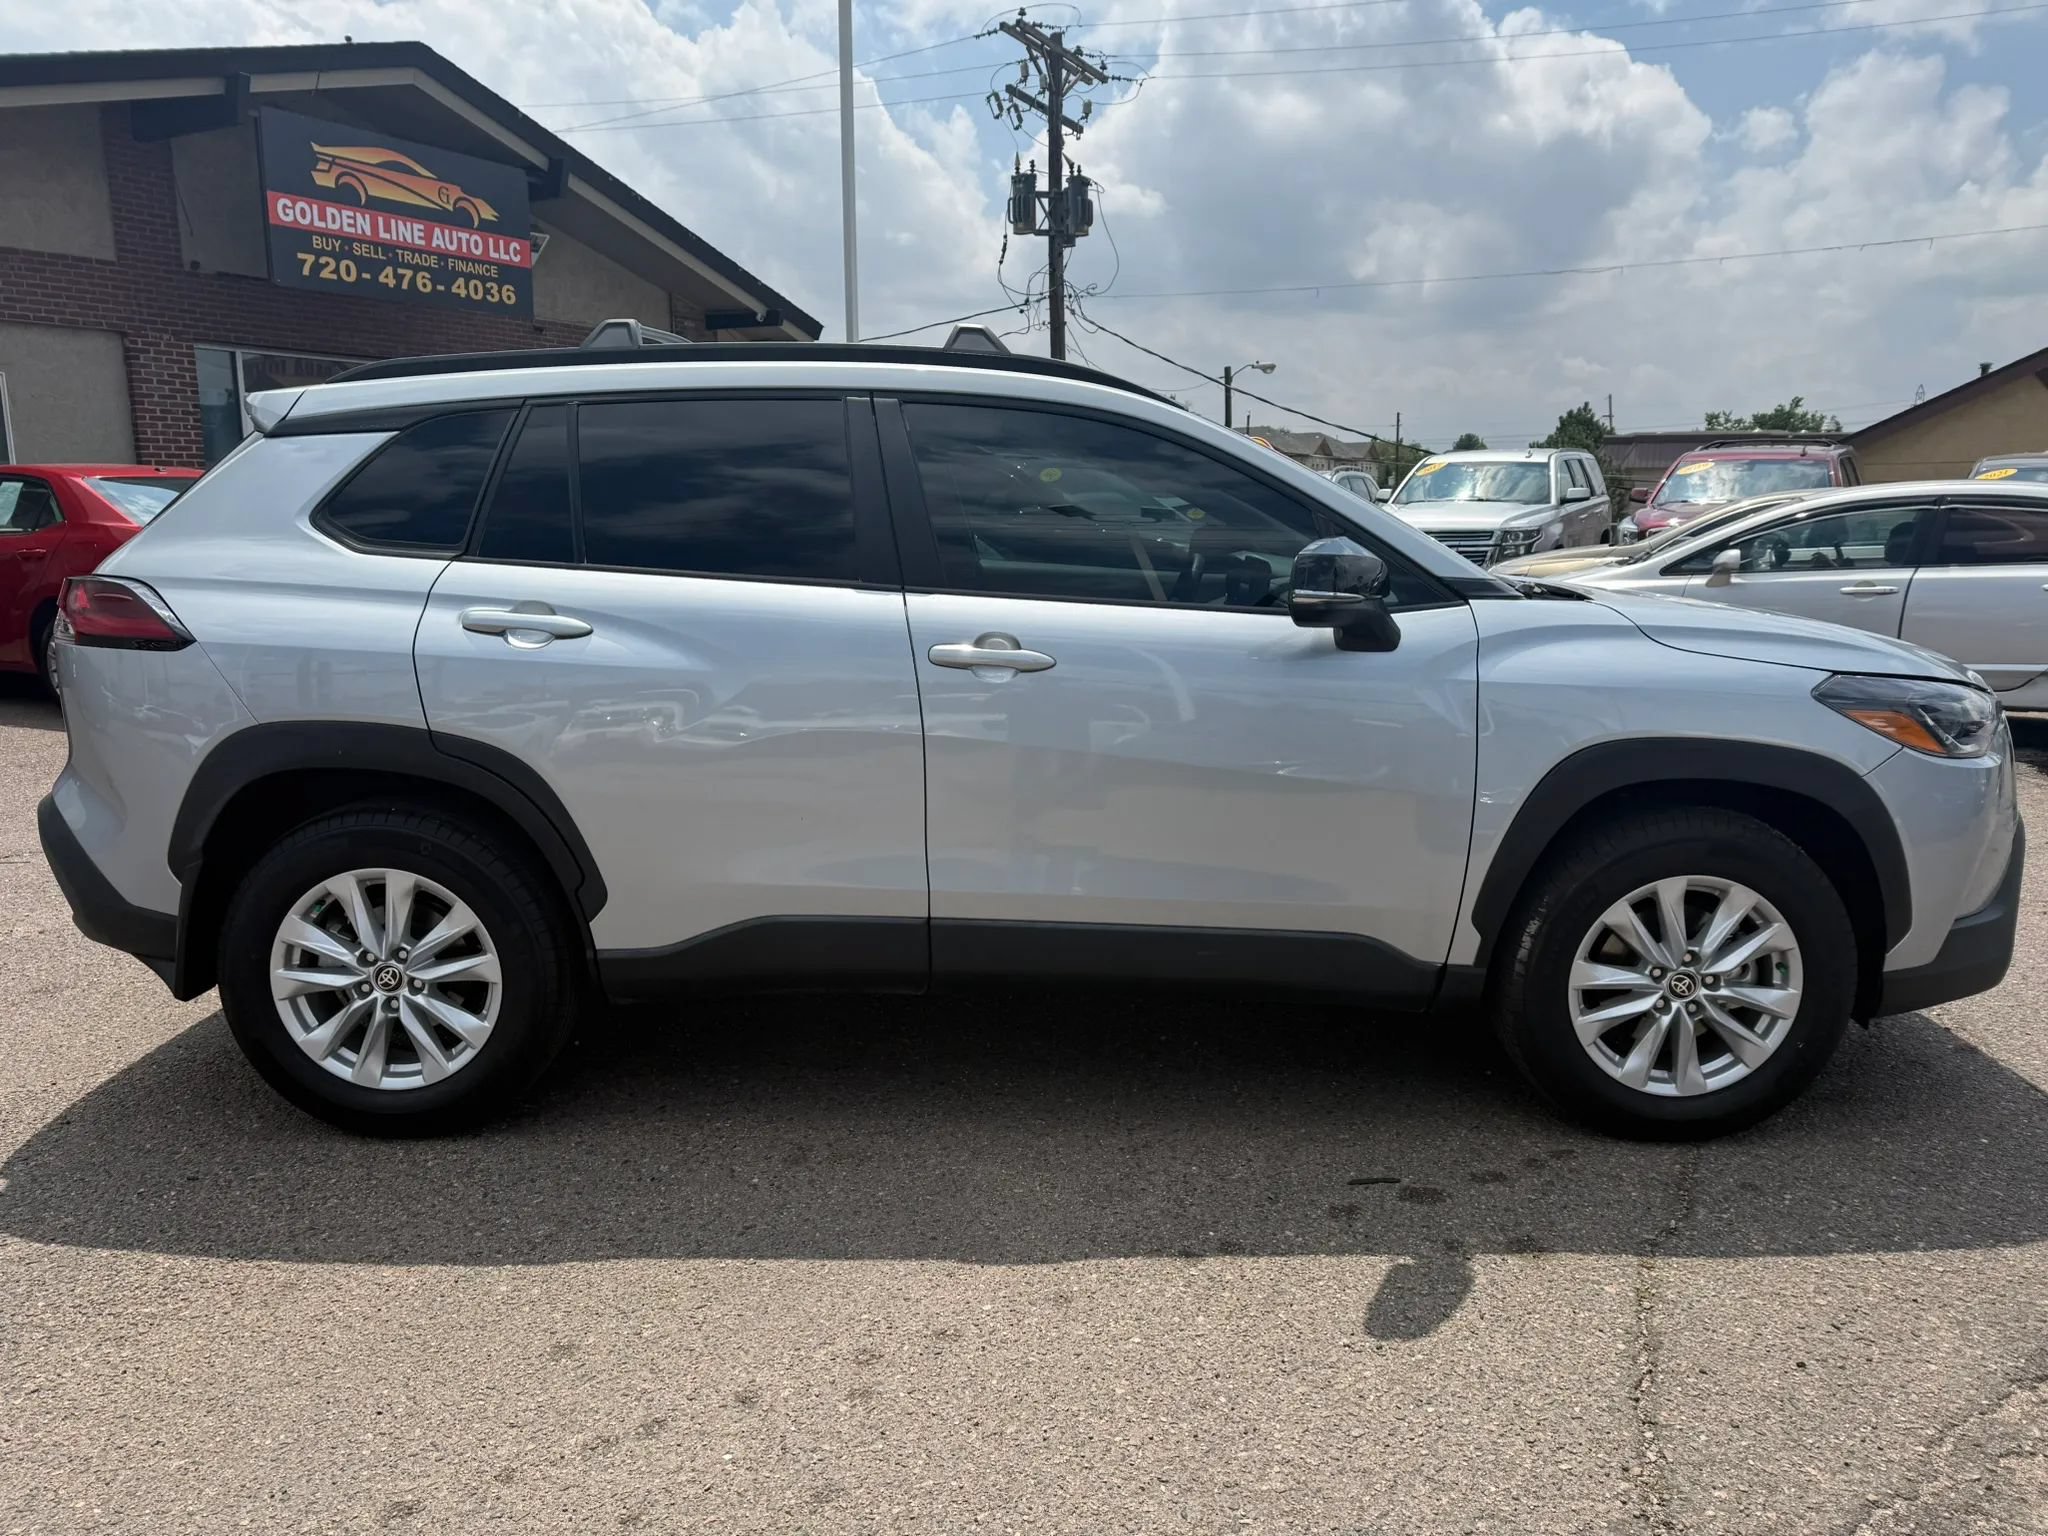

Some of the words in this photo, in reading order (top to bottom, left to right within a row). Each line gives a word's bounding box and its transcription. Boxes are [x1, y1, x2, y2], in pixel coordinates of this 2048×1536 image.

[277, 198, 371, 235] GOLDEN
[377, 215, 426, 246] LINE
[431, 226, 483, 256] AUTO
[488, 237, 521, 263] LLC
[312, 235, 342, 252] BUY
[352, 242, 387, 260] SELL
[396, 249, 439, 268] TRADE
[447, 258, 499, 278] FINANCE
